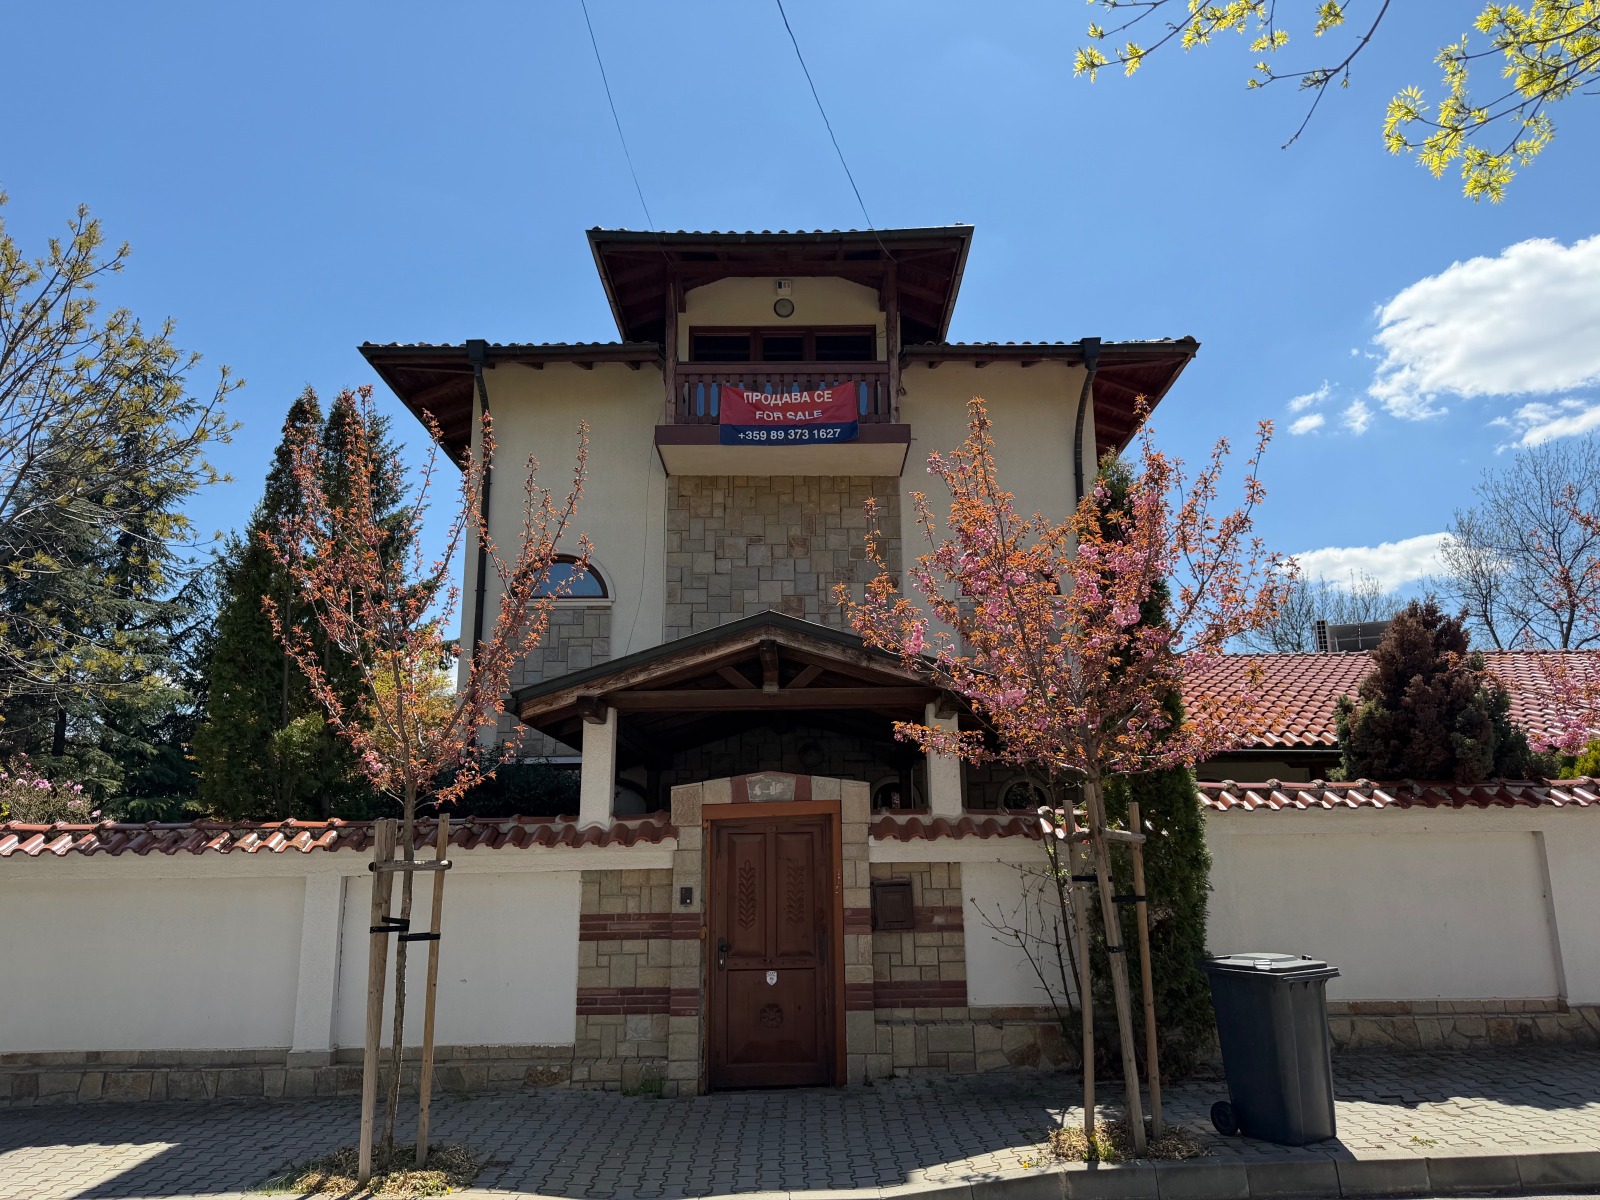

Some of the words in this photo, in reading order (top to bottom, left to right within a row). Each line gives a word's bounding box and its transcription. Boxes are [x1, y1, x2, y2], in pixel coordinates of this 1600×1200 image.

[743, 391, 811, 406] ПРОДАВА
[814, 390, 833, 402] СЕ
[755, 411, 783, 421] FOR
[786, 409, 823, 421] SALE
[738, 430, 767, 441] +359
[770, 430, 785, 440] 89
[787, 429, 809, 440] 373
[812, 428, 841, 439] 1627
